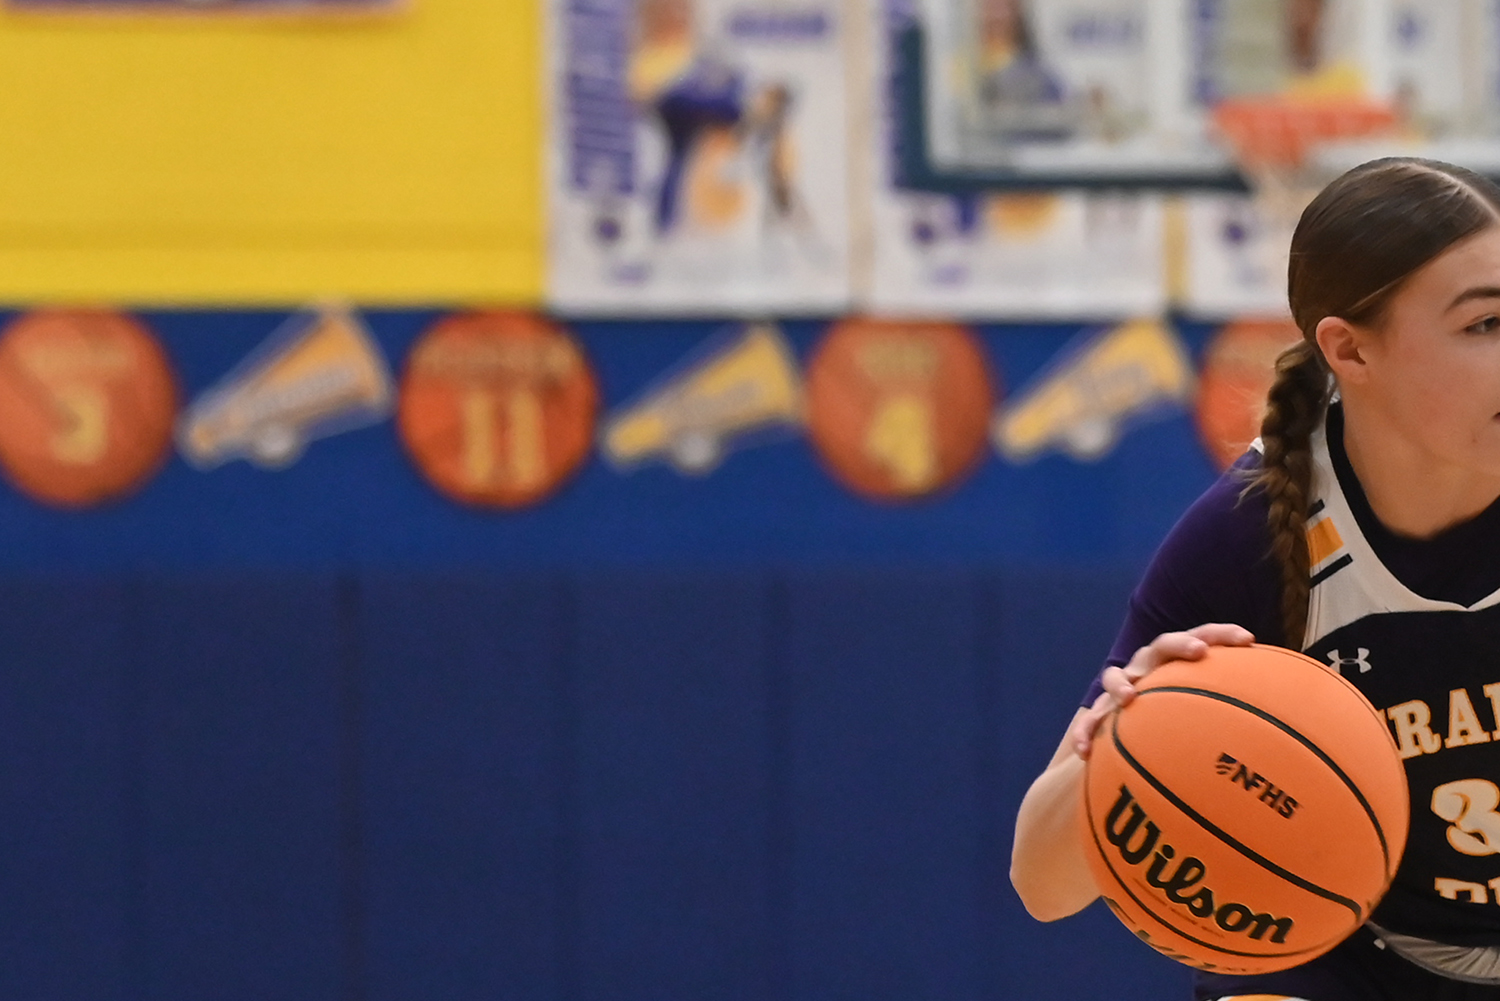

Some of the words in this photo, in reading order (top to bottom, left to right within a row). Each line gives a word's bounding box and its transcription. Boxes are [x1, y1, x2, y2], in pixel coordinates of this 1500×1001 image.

[461, 388, 547, 492] 11
[1231, 763, 1299, 820] NFHS
[1104, 783, 1295, 944] Wilson
